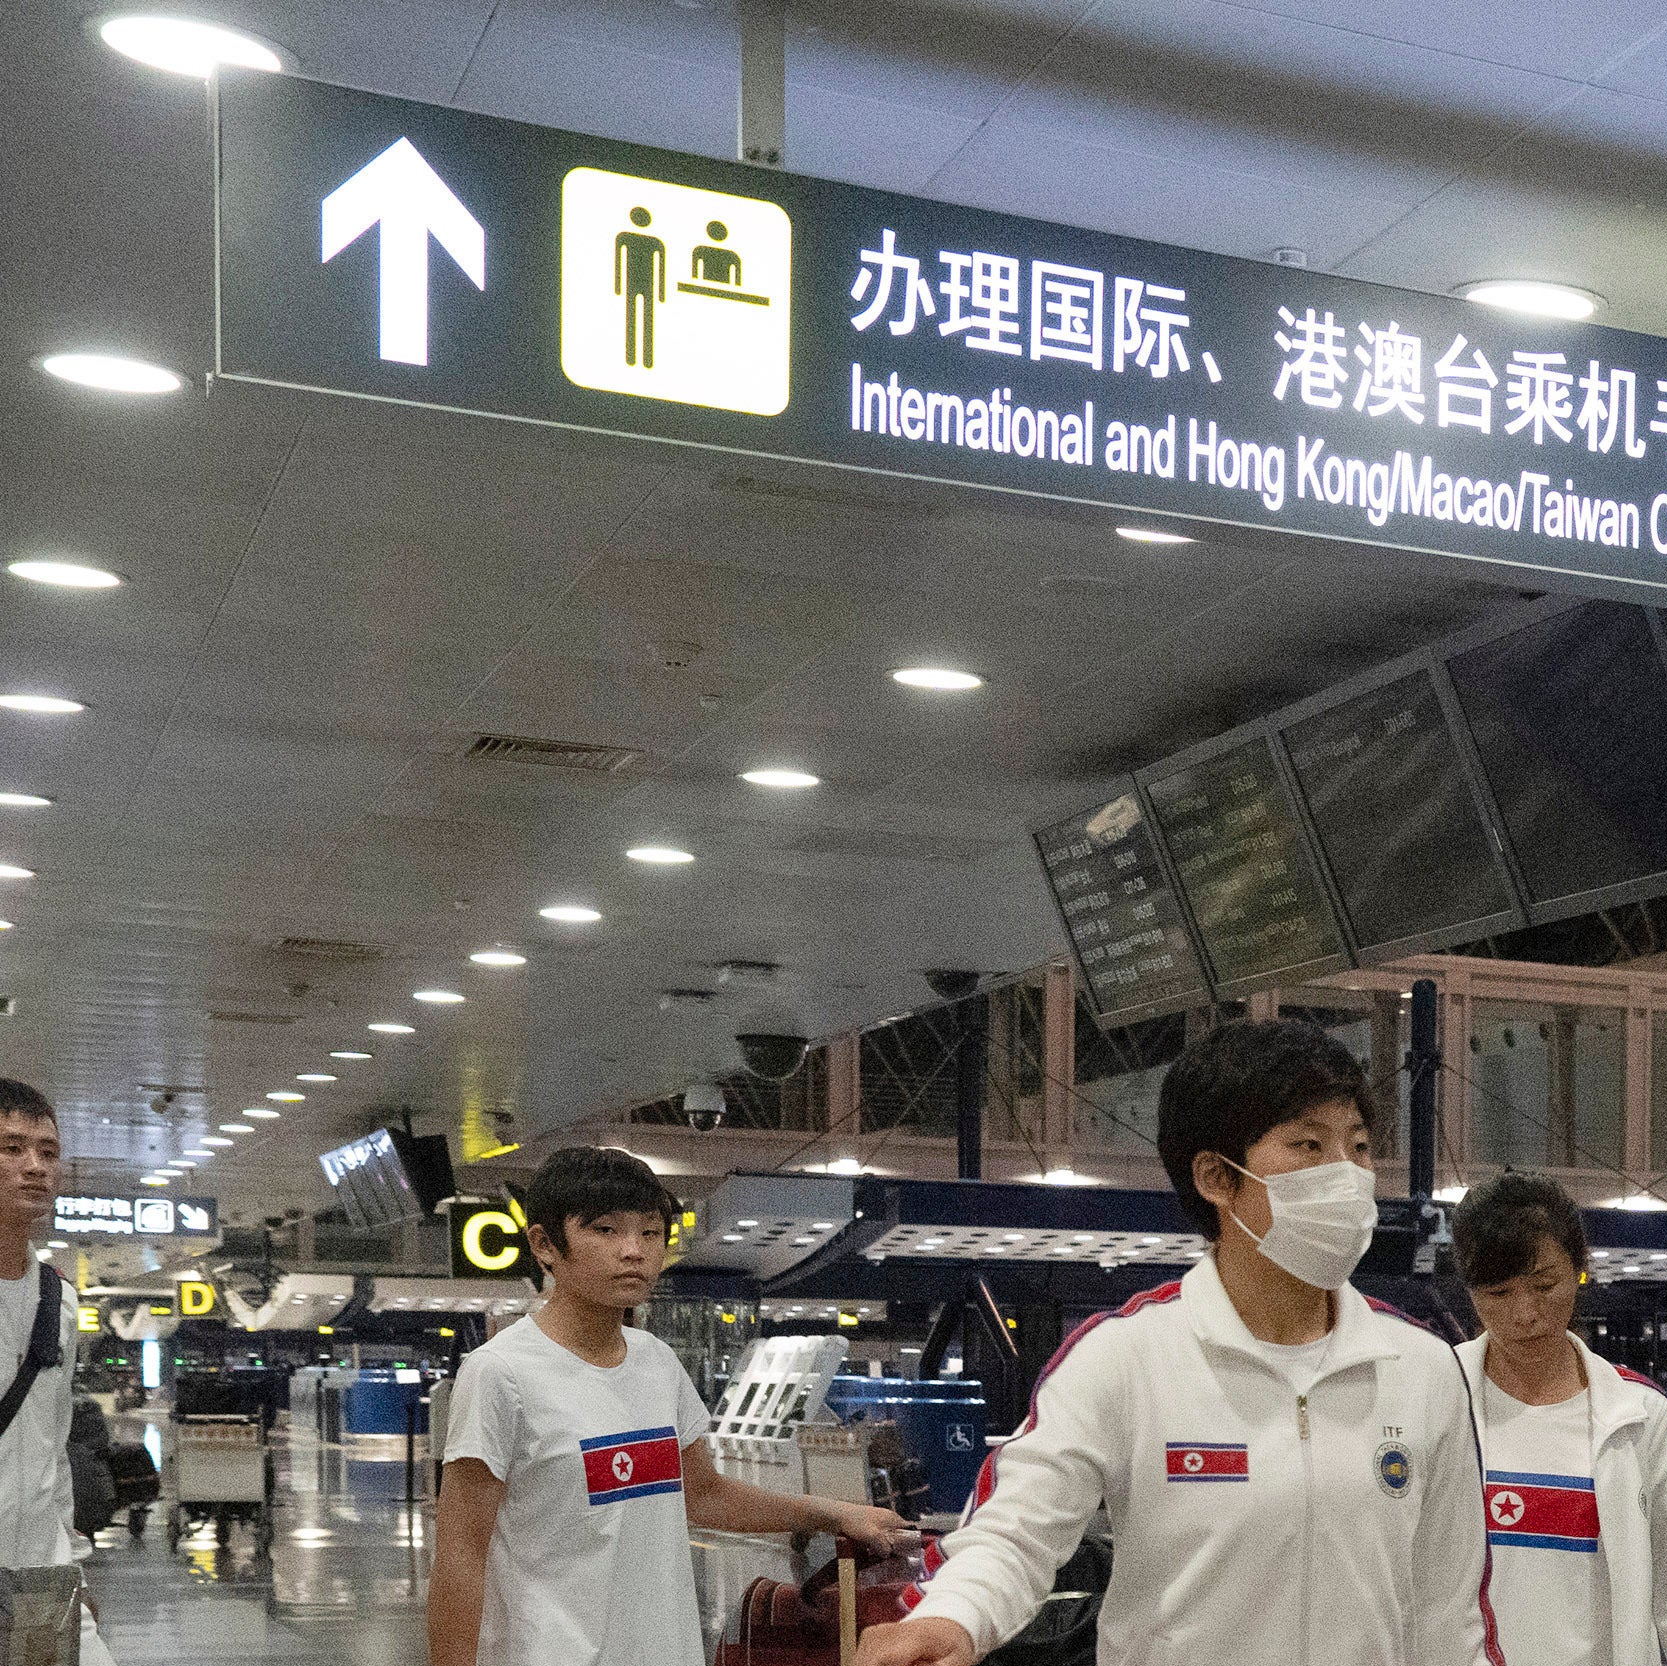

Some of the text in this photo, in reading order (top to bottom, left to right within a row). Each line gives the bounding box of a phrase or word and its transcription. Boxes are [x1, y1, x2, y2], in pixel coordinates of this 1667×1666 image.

[852, 363, 1093, 466] International
[1105, 413, 1176, 479] and
[1187, 418, 1286, 512] Hong
[1297, 436, 1640, 550] Kong/Macao/Taiwan
[461, 1210, 521, 1271] C
[181, 1282, 215, 1316] D
[77, 1307, 100, 1332] E
[1383, 1426, 1403, 1437] ITF
